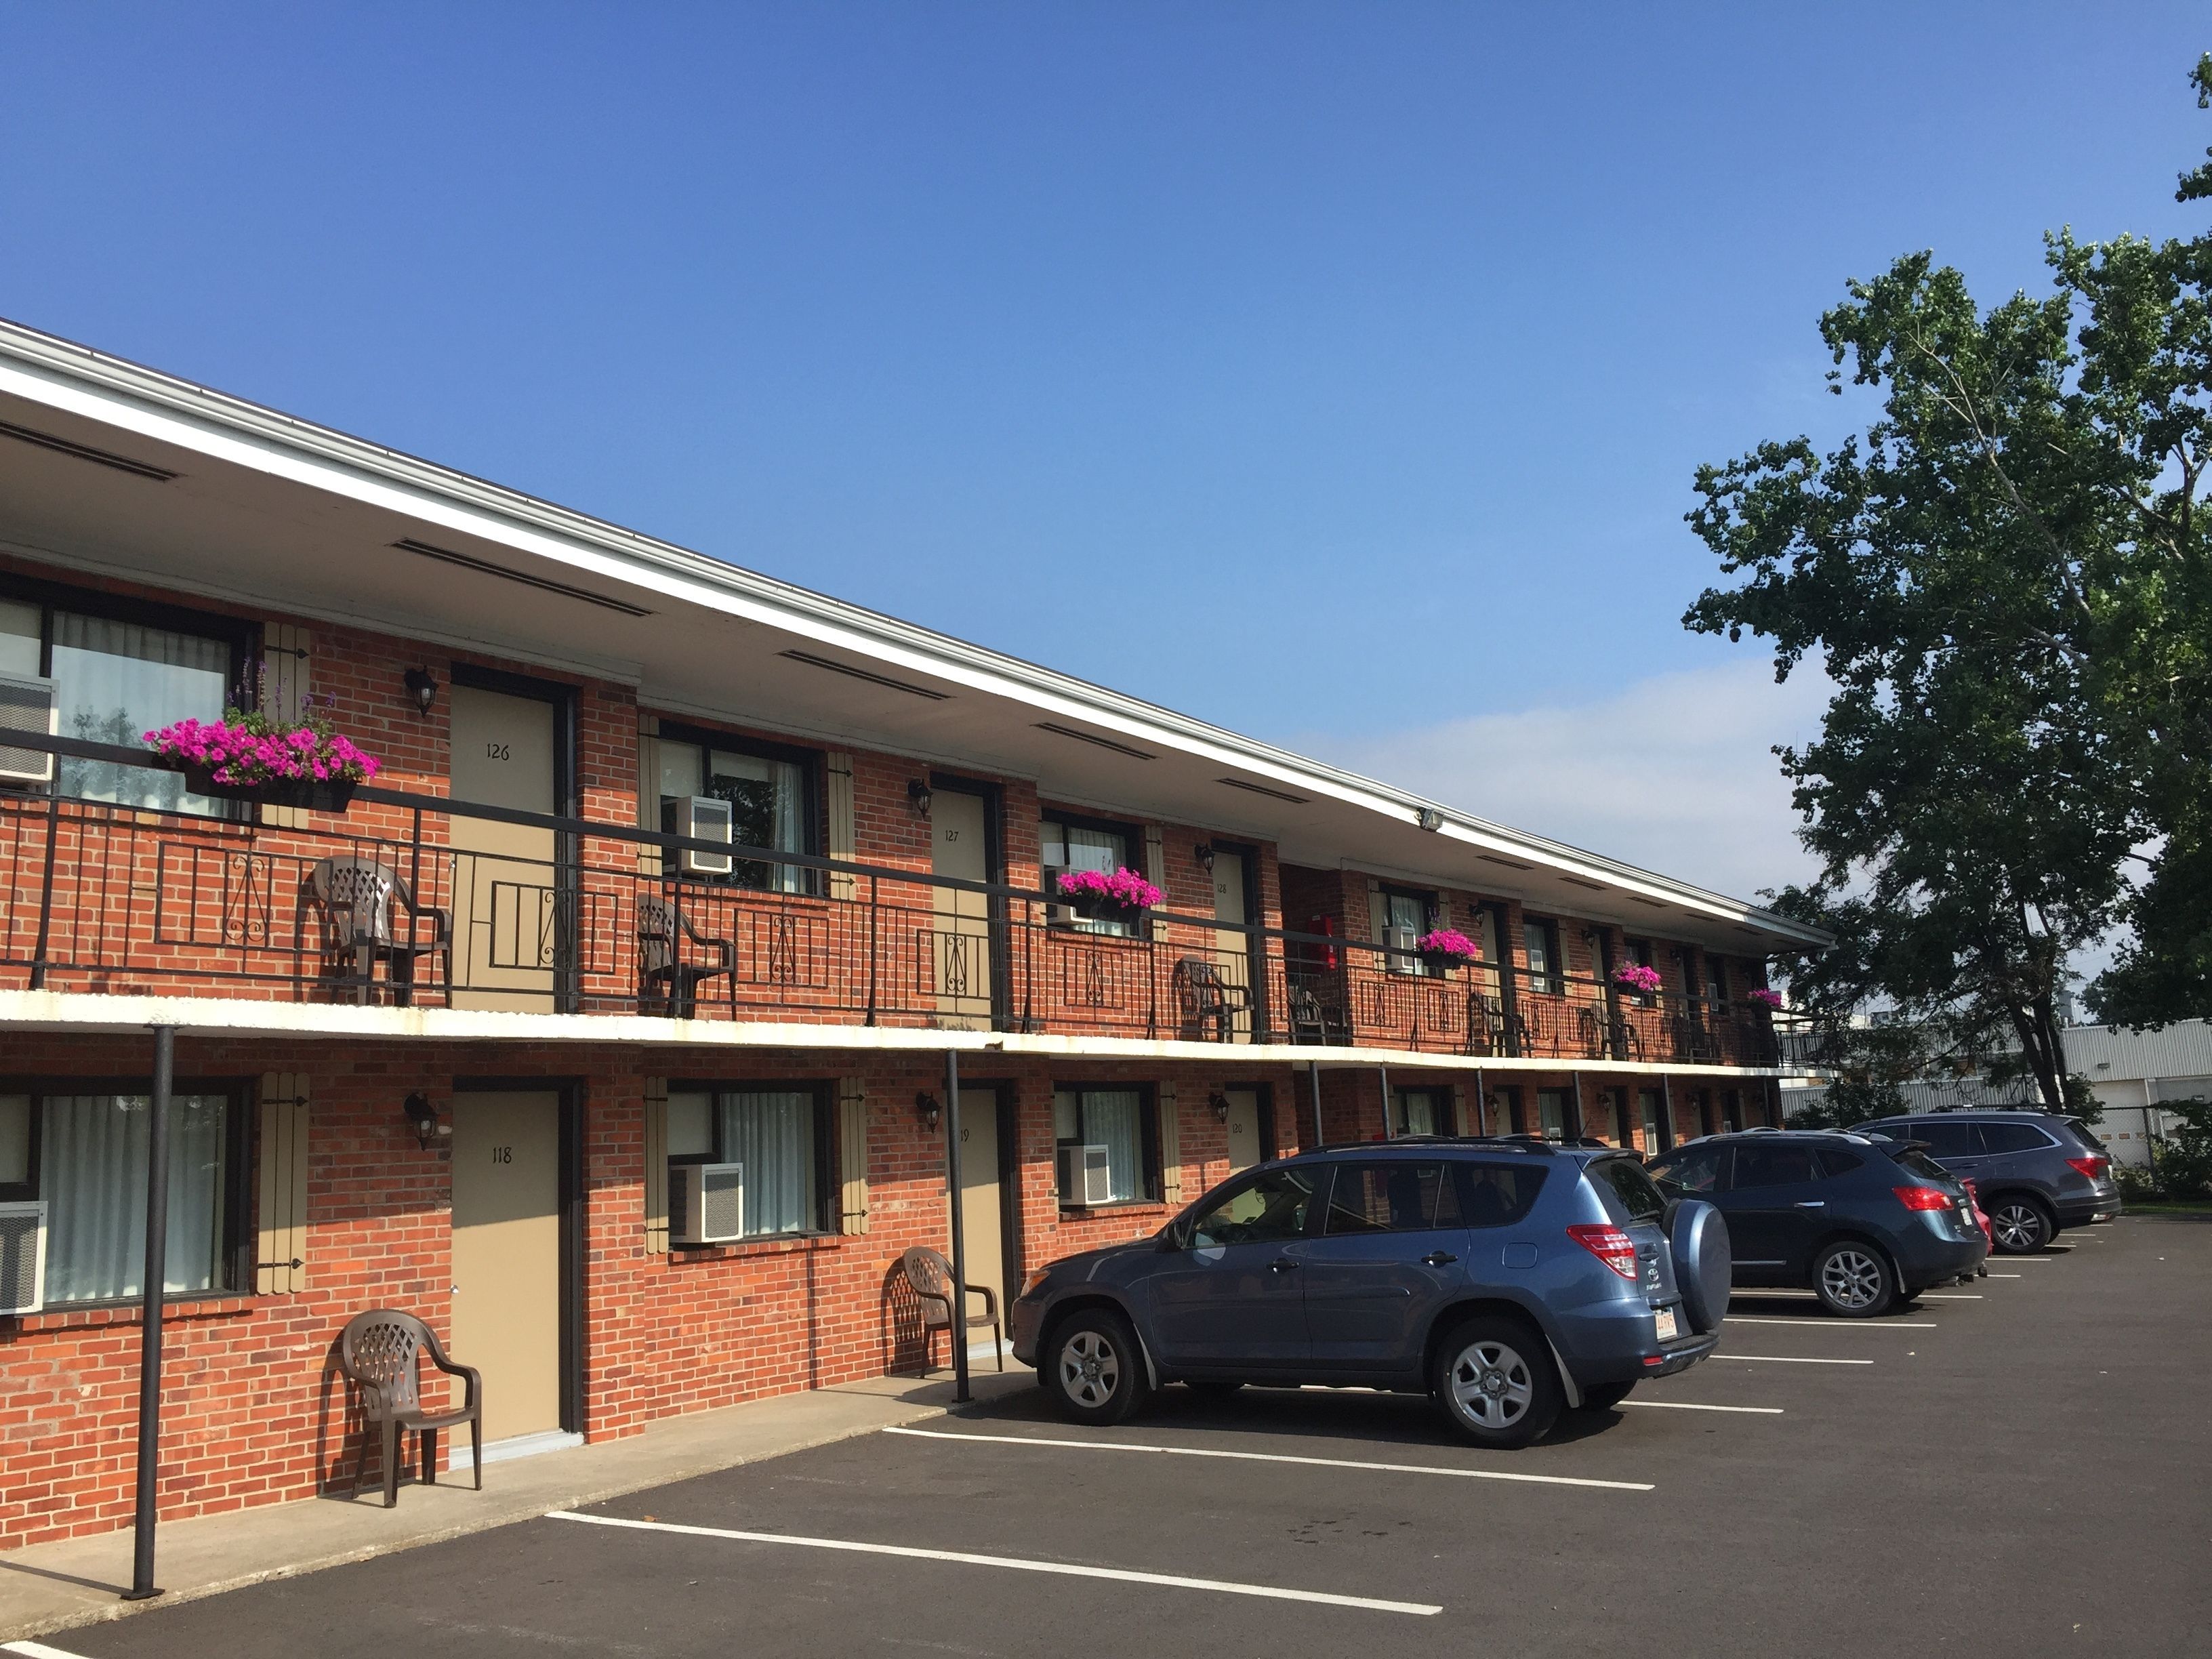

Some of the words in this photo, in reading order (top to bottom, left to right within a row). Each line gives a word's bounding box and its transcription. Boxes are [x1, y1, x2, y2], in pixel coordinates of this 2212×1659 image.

[487, 743, 510, 761] 126
[945, 830, 959, 842] 127
[1217, 883, 1227, 894] 128
[1232, 1123, 1242, 1133] 120
[960, 1128, 970, 1142] 19
[493, 1147, 512, 1164] 118
